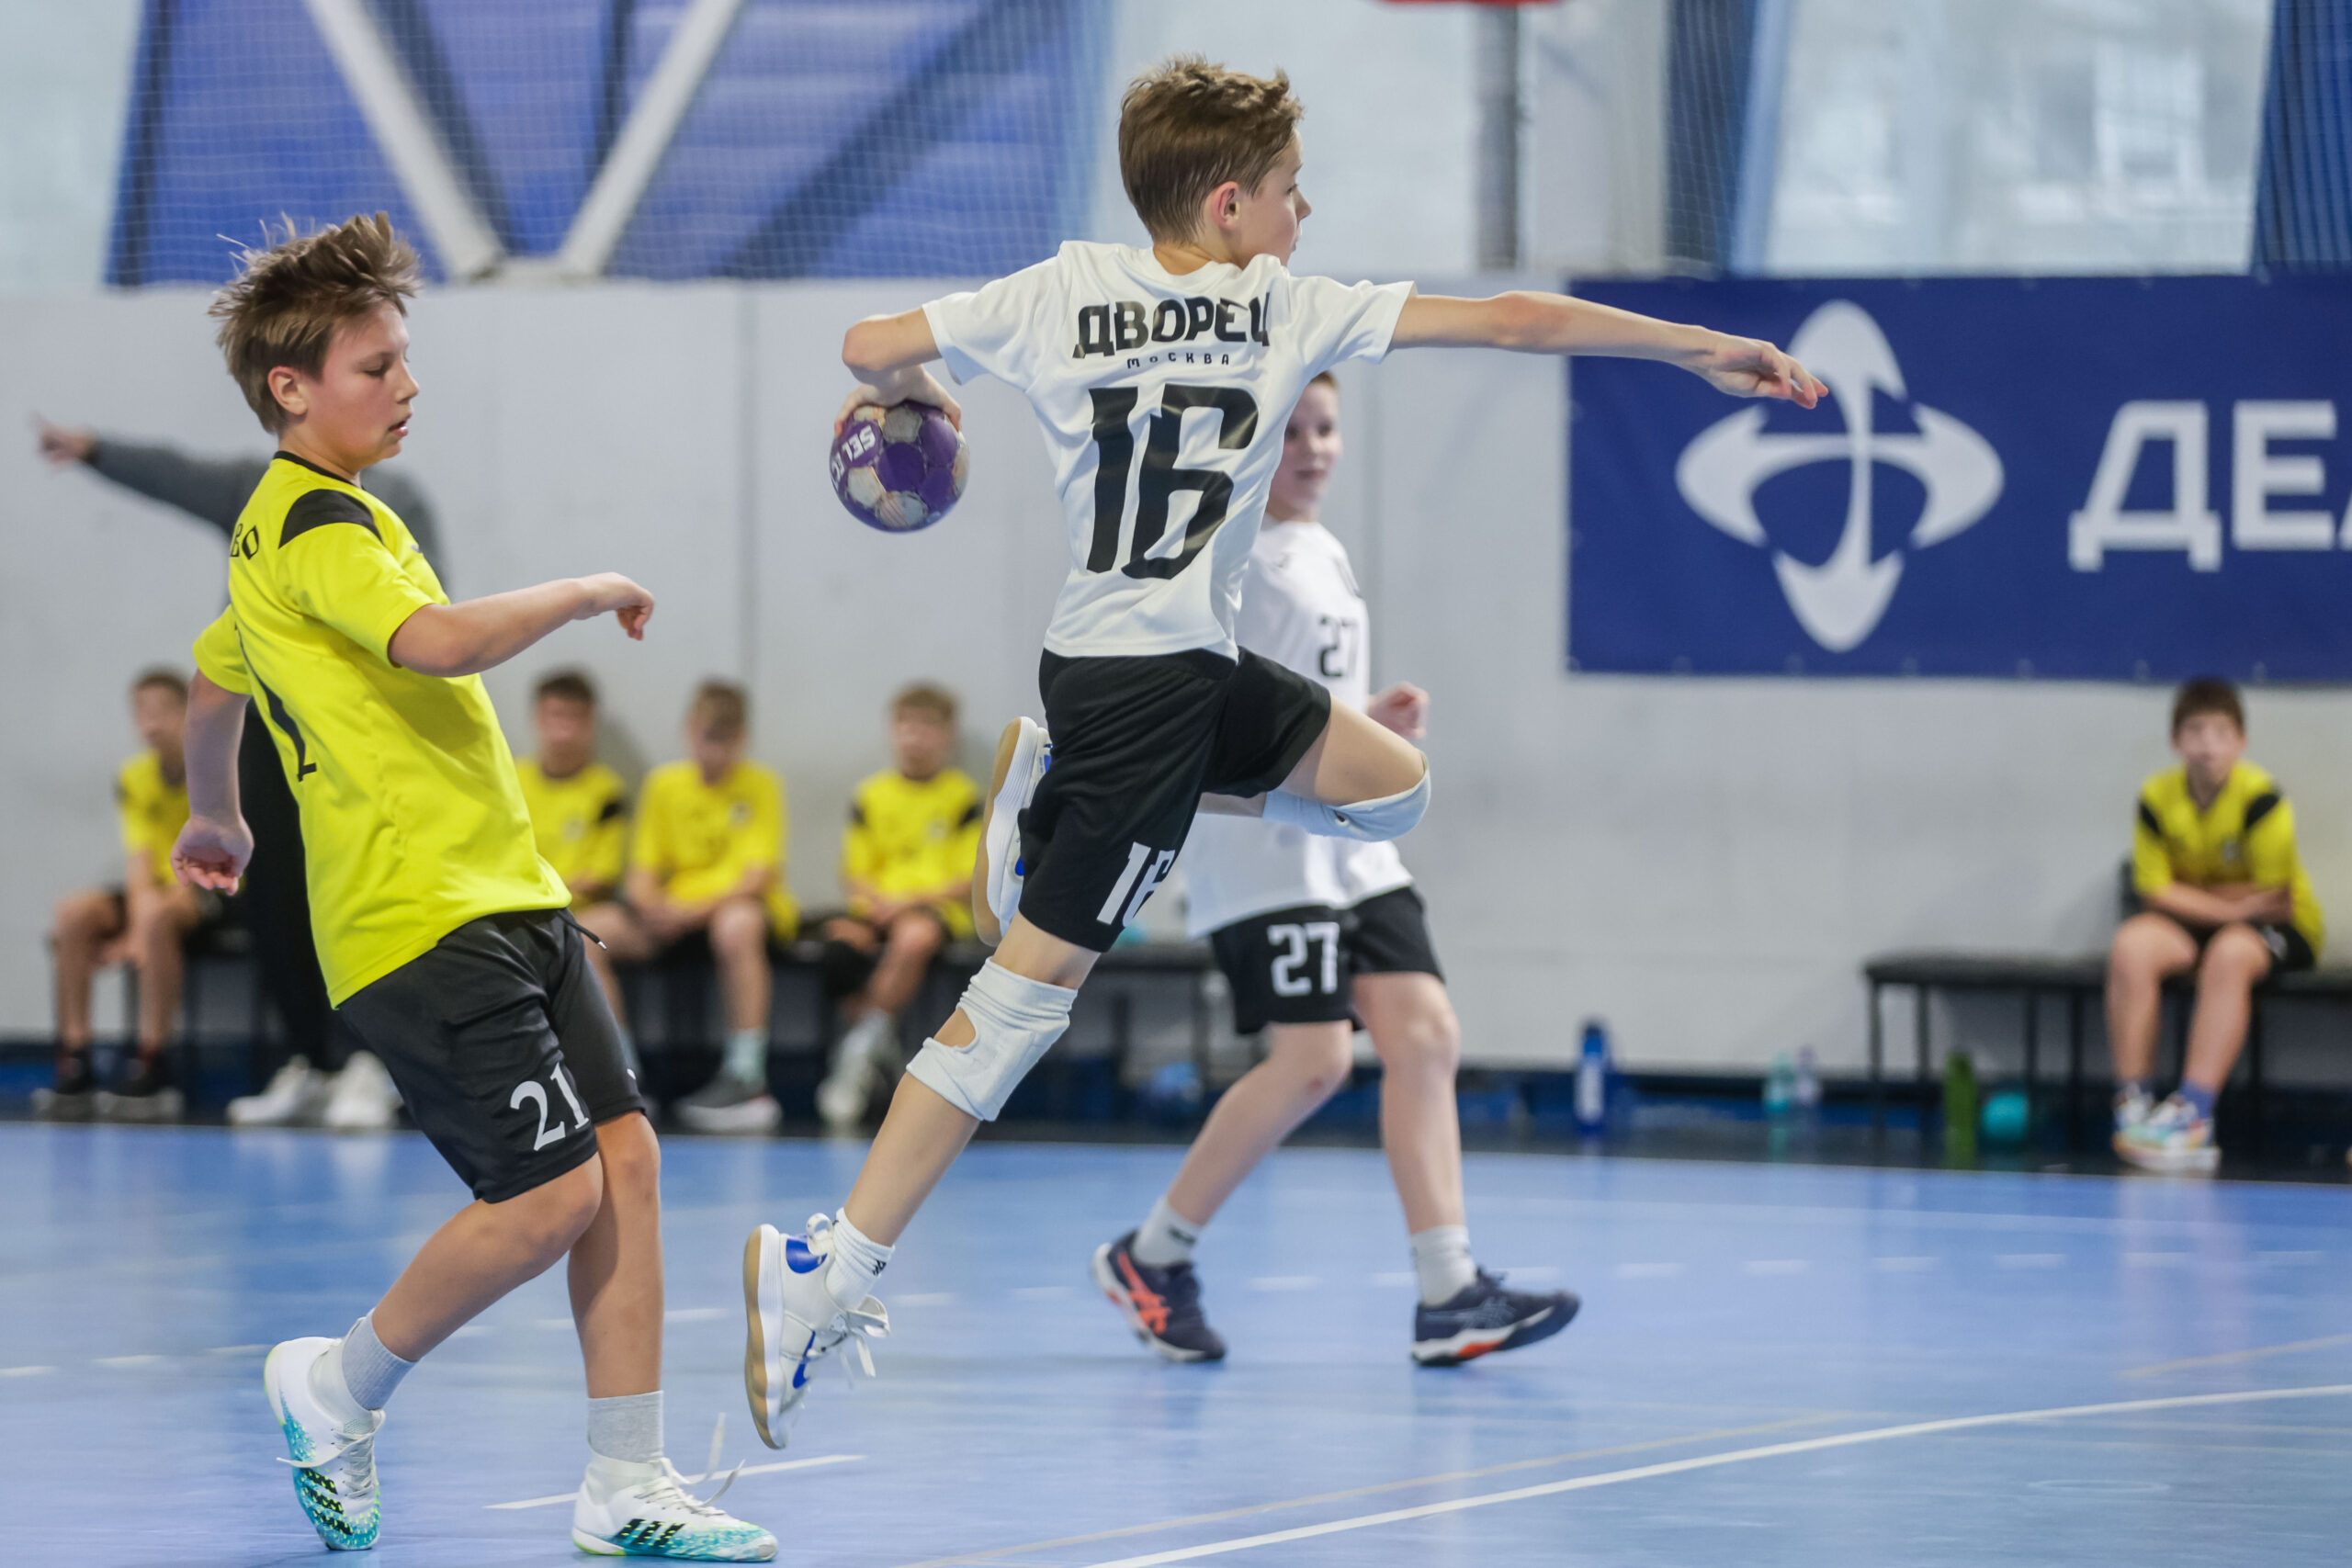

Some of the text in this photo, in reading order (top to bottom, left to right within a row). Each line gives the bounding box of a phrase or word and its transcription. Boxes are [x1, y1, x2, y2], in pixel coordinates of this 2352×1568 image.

[1072, 292, 1270, 359] ДВОРЕЦ
[1126, 352, 1229, 369] МОСКВА
[1086, 383, 1259, 580] 16
[2068, 398, 2352, 573] ДЕ
[1267, 921, 1340, 997] 27
[510, 1062, 590, 1151] 21
